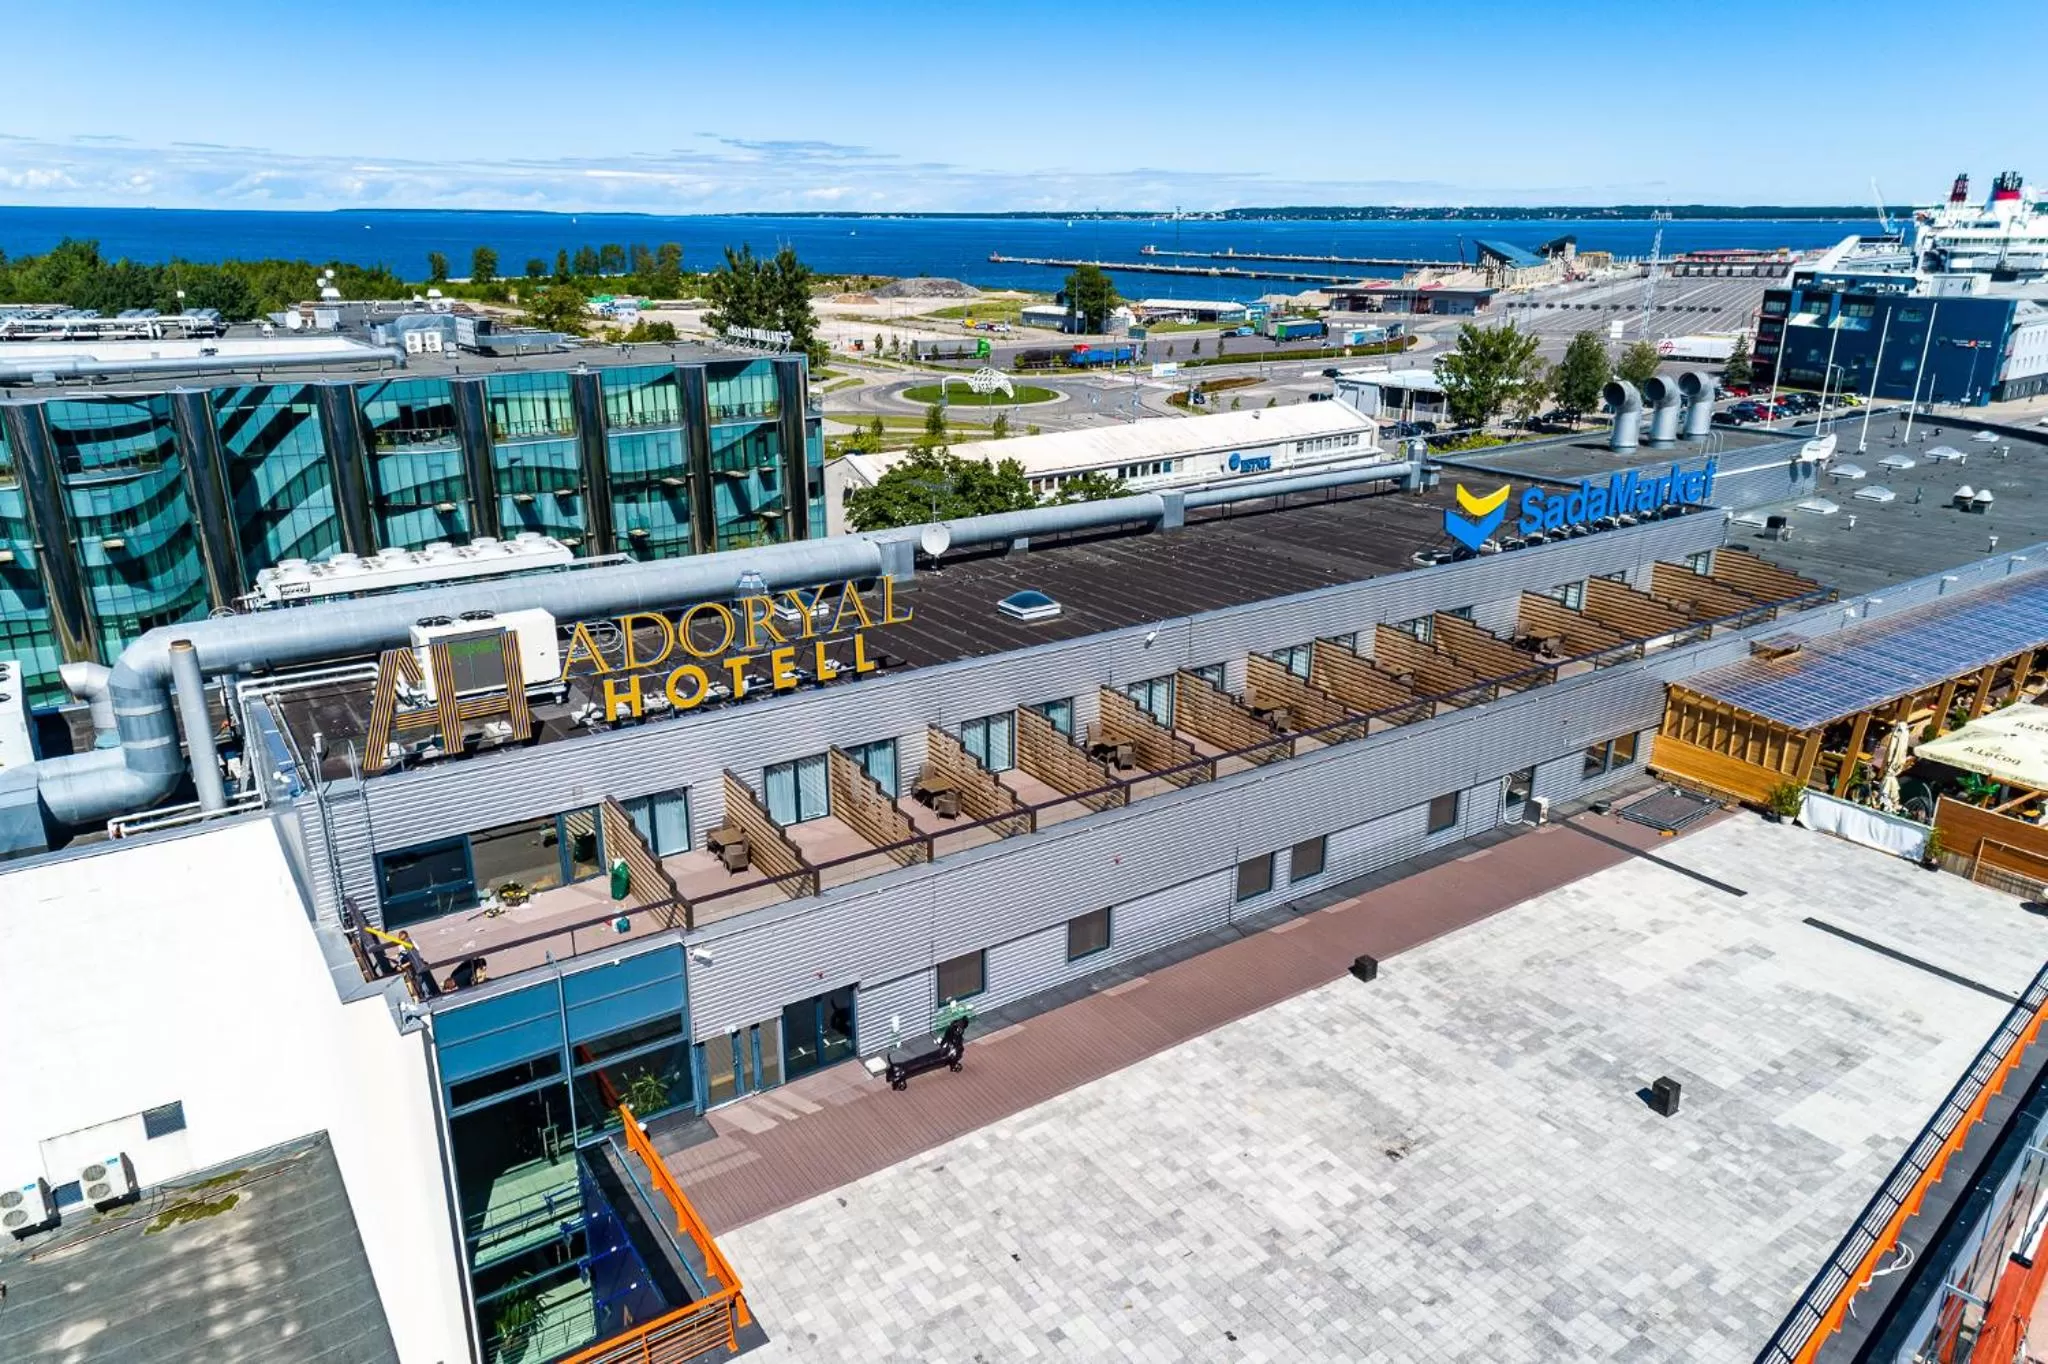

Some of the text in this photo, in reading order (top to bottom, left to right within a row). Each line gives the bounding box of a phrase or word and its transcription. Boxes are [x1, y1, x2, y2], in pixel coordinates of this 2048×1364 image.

[1519, 457, 1716, 535] SadaMarket
[561, 575, 914, 681] ADORYAL
[603, 634, 876, 722] HOTELL
